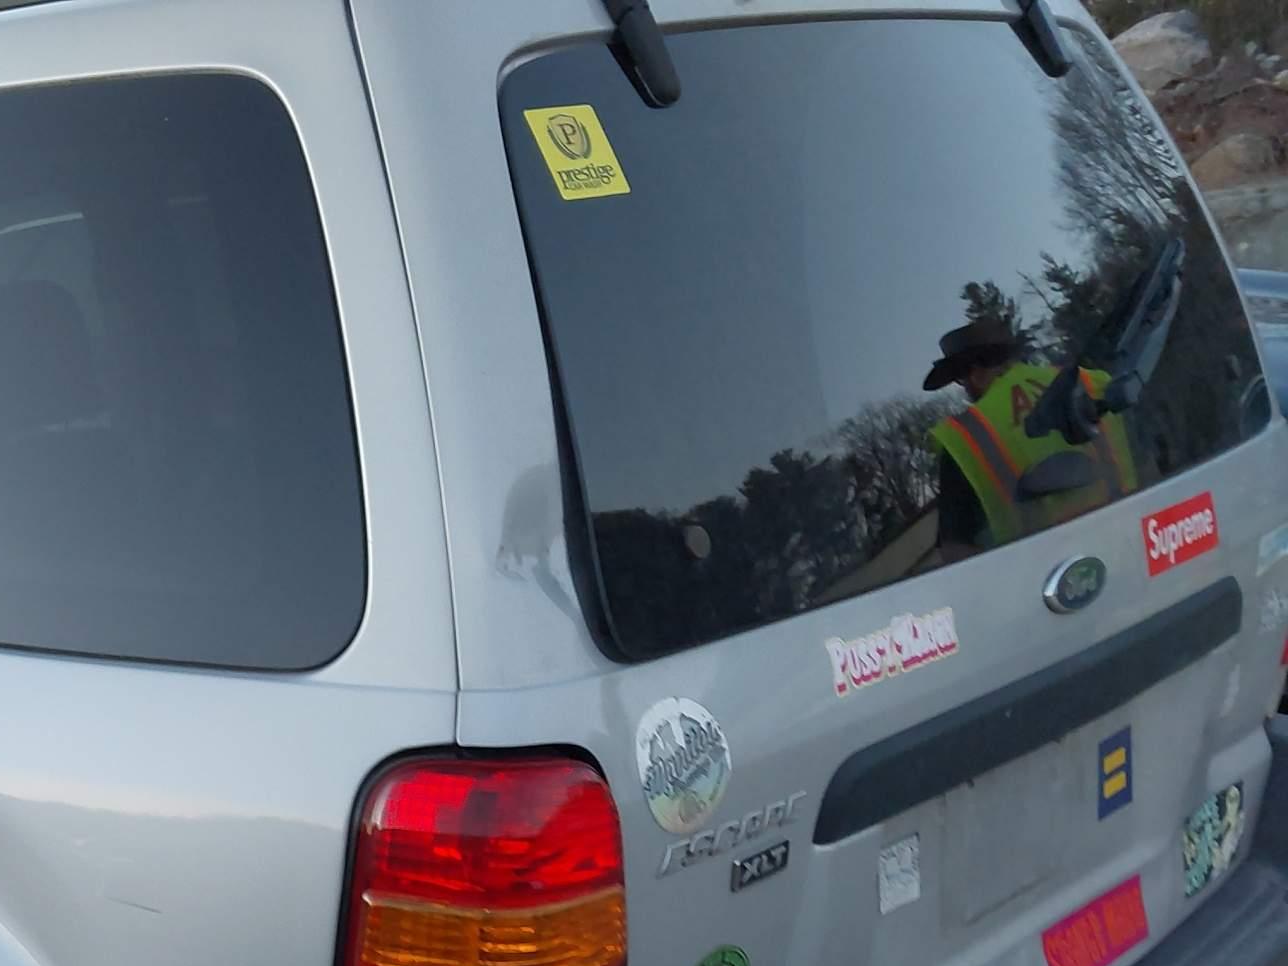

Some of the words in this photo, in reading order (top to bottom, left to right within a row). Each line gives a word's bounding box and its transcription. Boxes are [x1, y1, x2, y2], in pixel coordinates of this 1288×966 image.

[556, 163, 616, 190] prestige
[1147, 508, 1214, 564] Supreme
[741, 846, 787, 882] XLT
